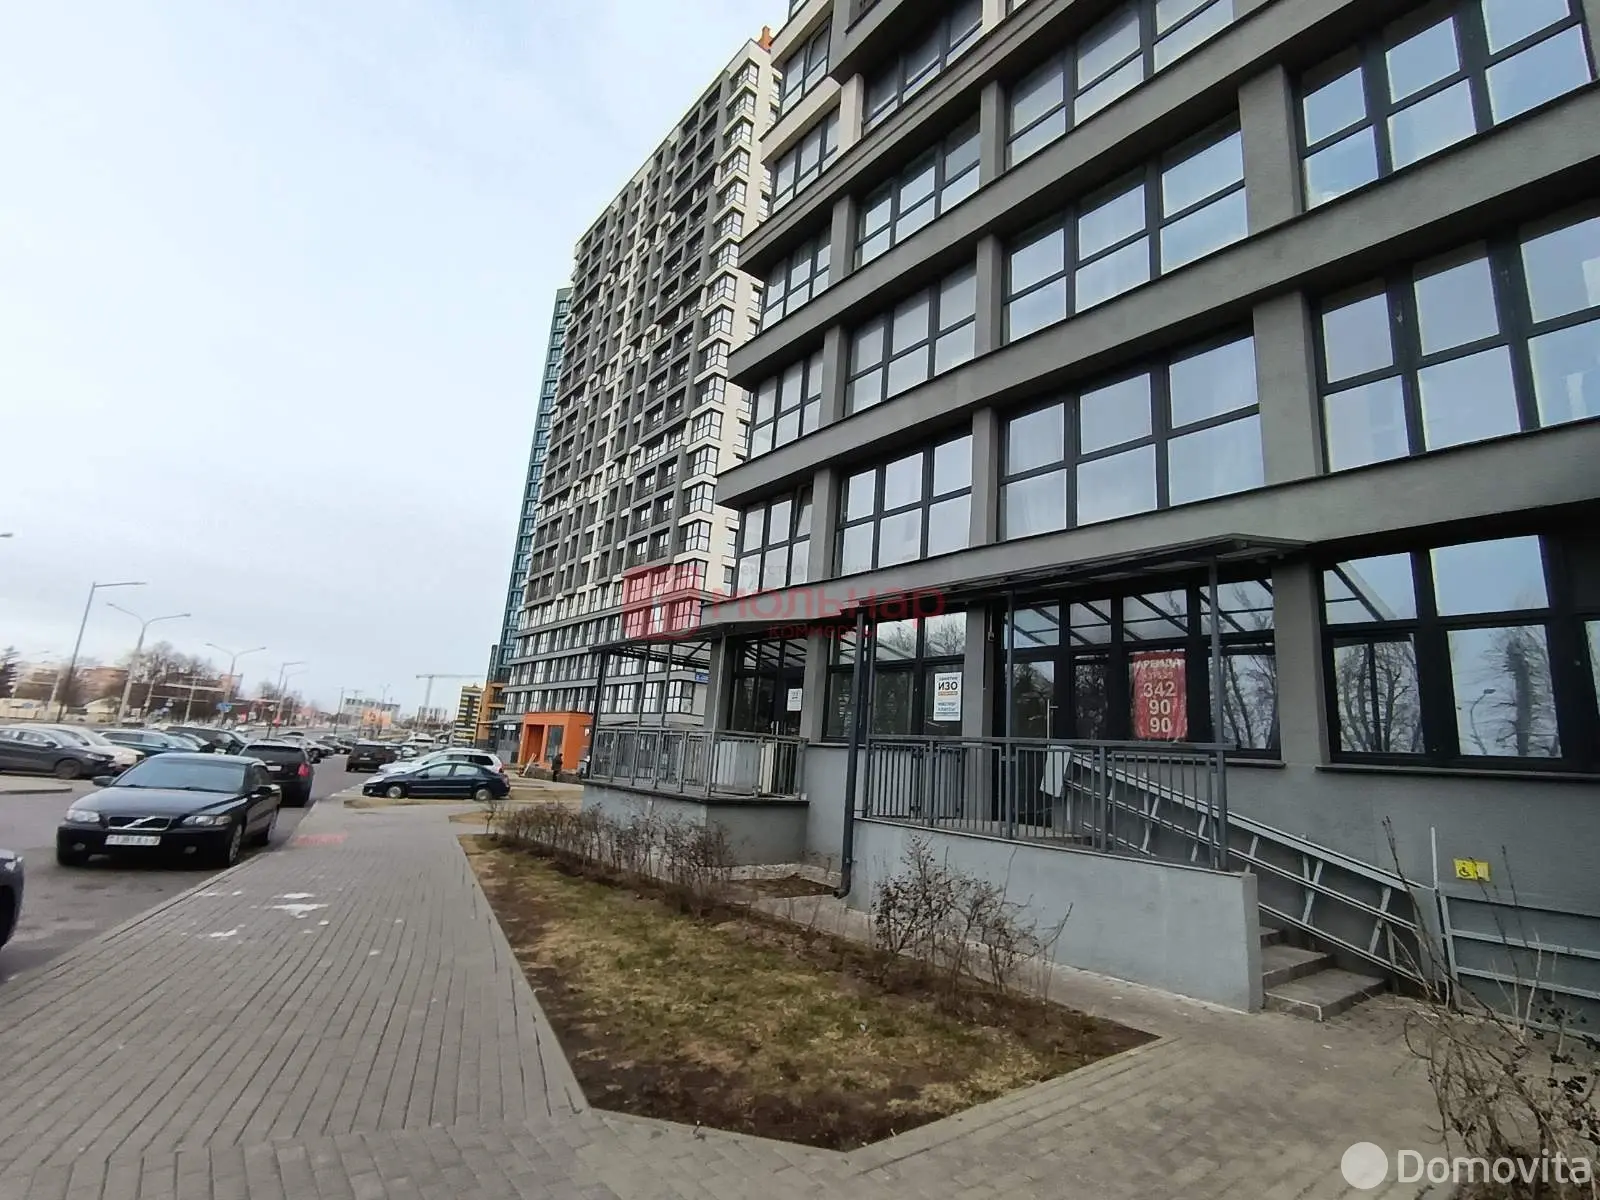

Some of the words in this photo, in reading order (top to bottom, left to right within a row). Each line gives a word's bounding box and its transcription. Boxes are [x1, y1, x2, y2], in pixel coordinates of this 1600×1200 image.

[938, 681, 958, 691] ИЗО
[1143, 681, 1177, 698] 342
[1149, 699, 1171, 715] 90
[1150, 717, 1172, 733] 90
